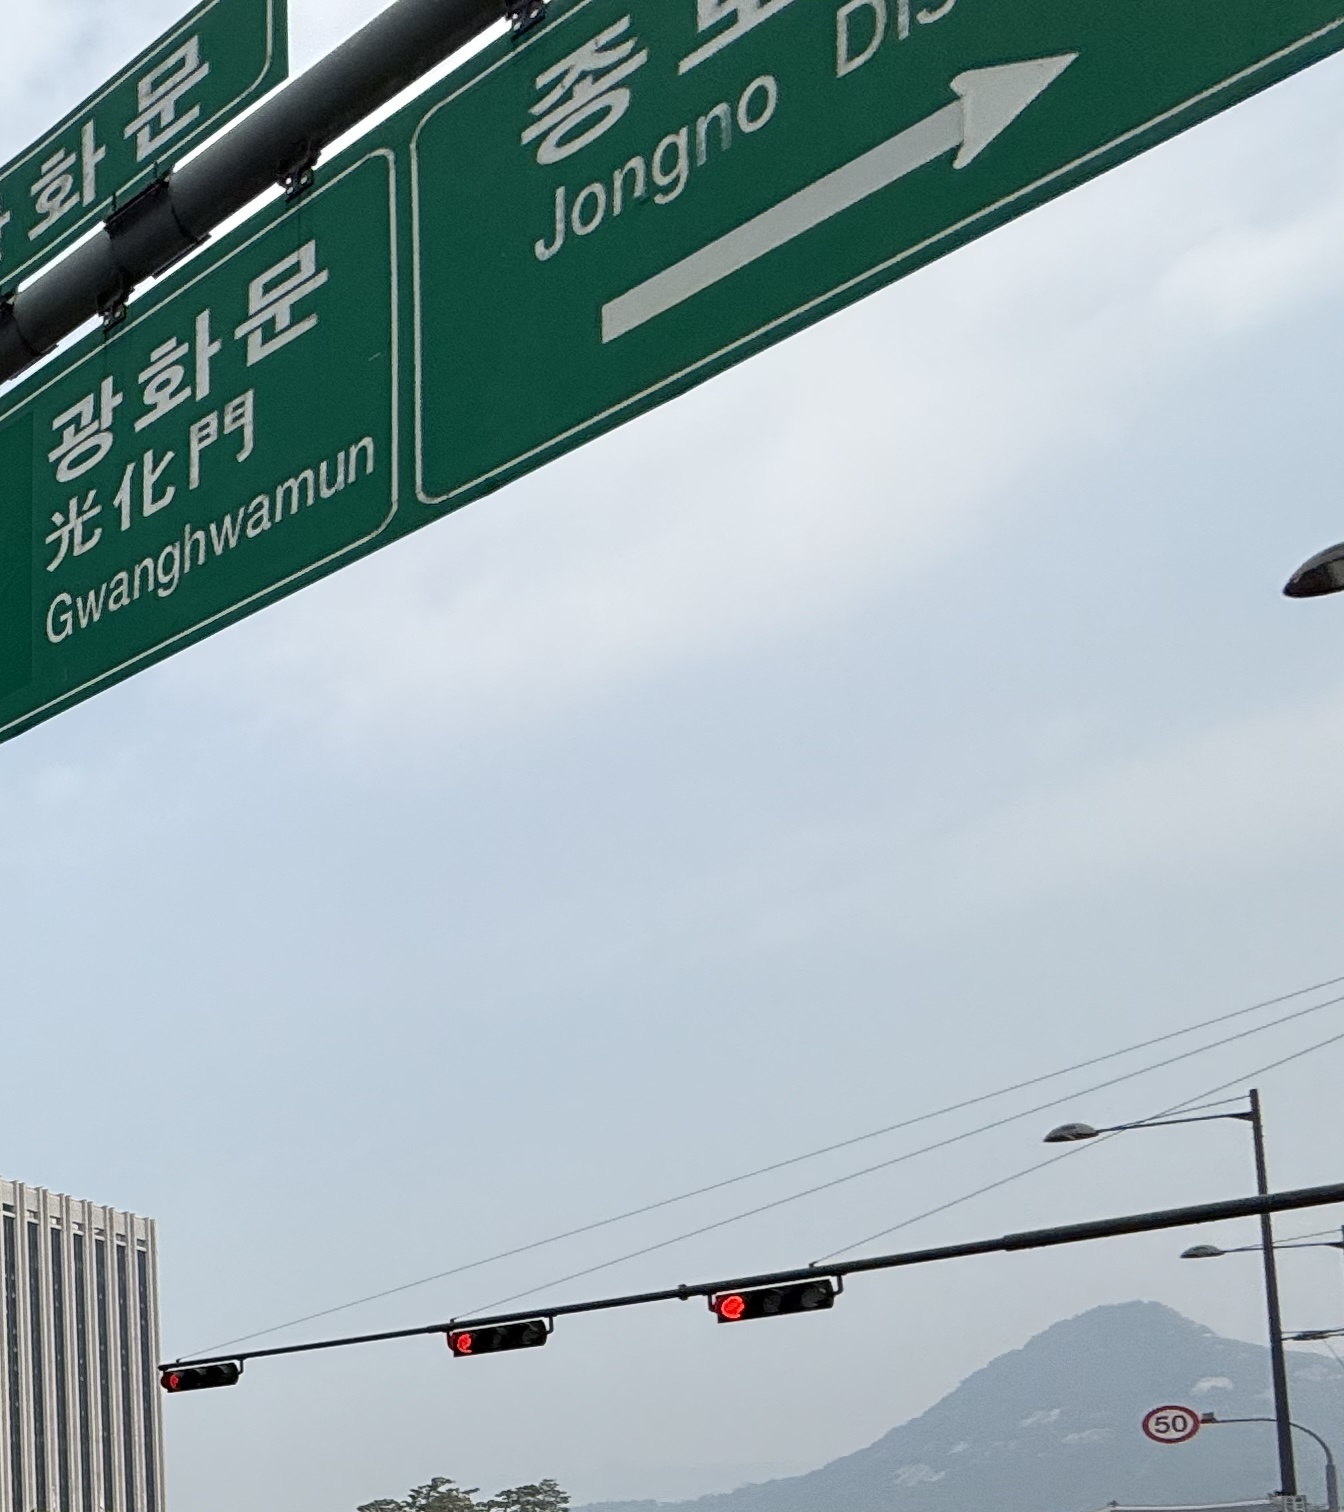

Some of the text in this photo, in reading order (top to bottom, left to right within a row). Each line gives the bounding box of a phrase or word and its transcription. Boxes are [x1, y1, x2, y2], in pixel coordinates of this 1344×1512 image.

[534, 75, 777, 262] Jongno
[47, 240, 329, 483] 광화문
[45, 389, 256, 572] 光化門
[45, 435, 376, 644] Gwanghwamun
[1154, 1415, 1188, 1434] 50
